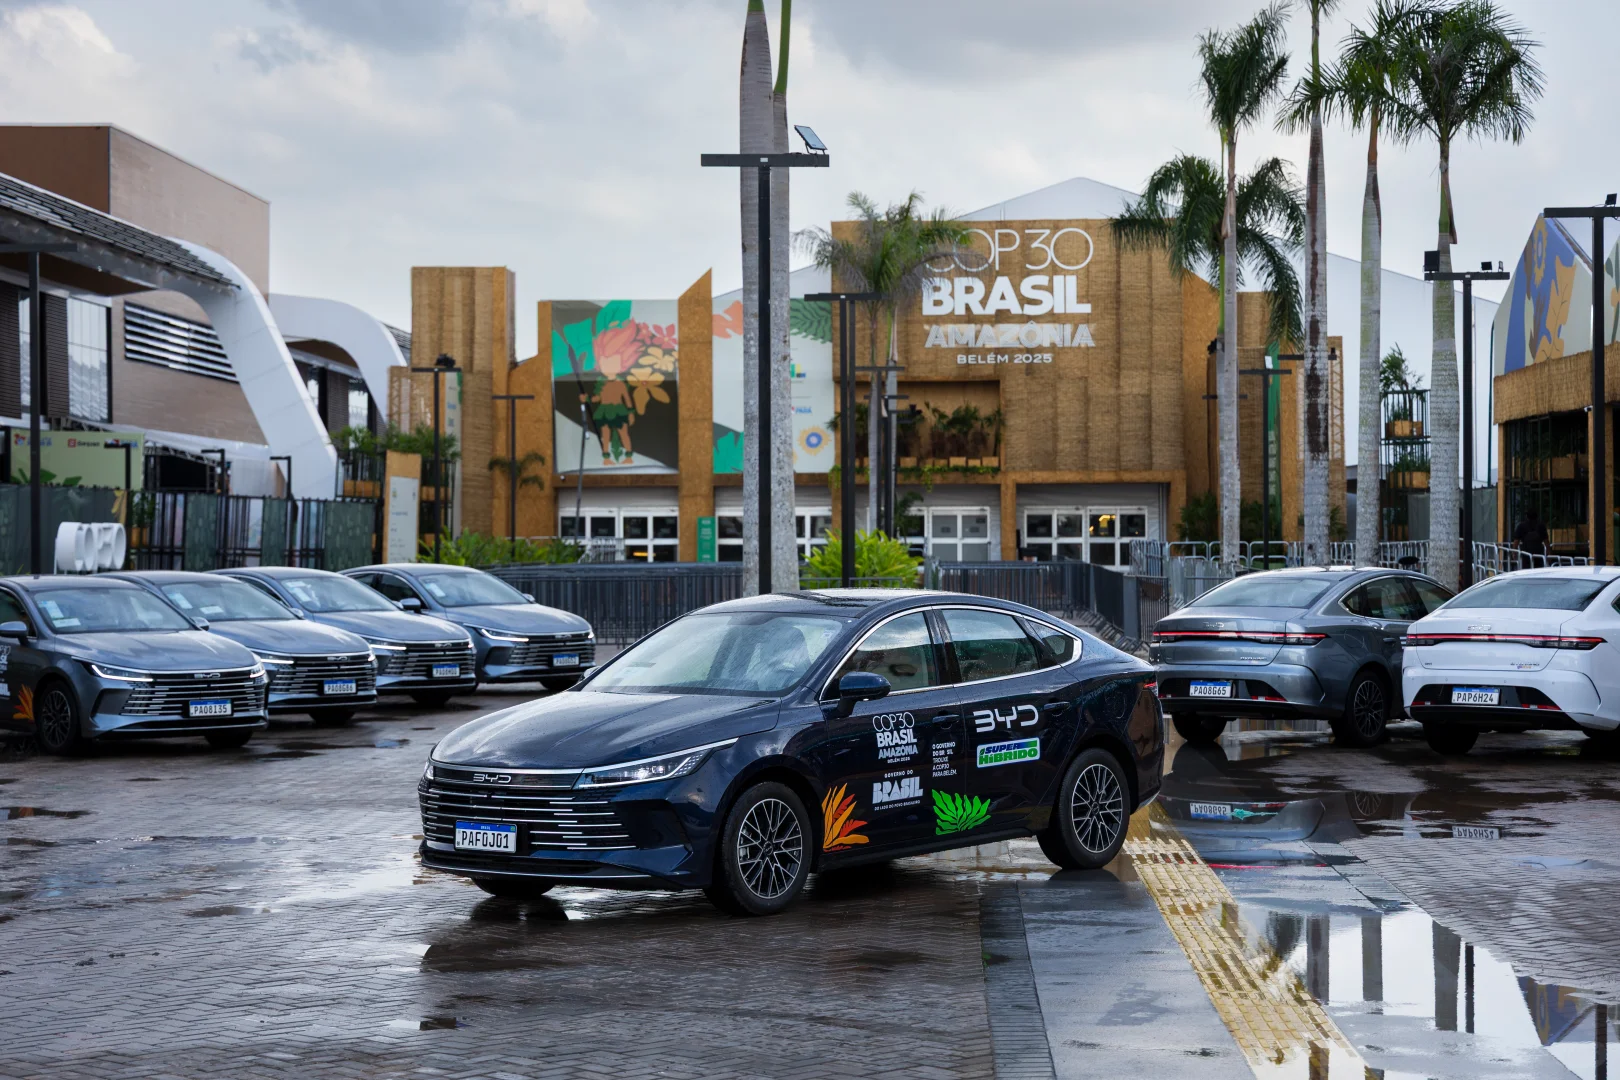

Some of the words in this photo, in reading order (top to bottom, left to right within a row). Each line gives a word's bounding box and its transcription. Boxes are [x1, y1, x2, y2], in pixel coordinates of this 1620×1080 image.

[921, 274, 1092, 316] BRASIL
[924, 320, 1096, 348] AMAZÔNIA
[956, 352, 1009, 364] BELÉM
[1013, 353, 1053, 364] 2025
[1456, 692, 1494, 703] PAP6H24
[872, 711, 915, 732] COP30
[972, 704, 1039, 733] BYD
[876, 728, 918, 748] BRASIL
[935, 741, 956, 750] GOVERNO
[878, 744, 919, 760] AMAZÔNIA
[984, 742, 1021, 754] SUPER
[473, 773, 512, 784] BYD
[884, 770, 906, 778] GOVERNO
[872, 776, 924, 804] BRASIL
